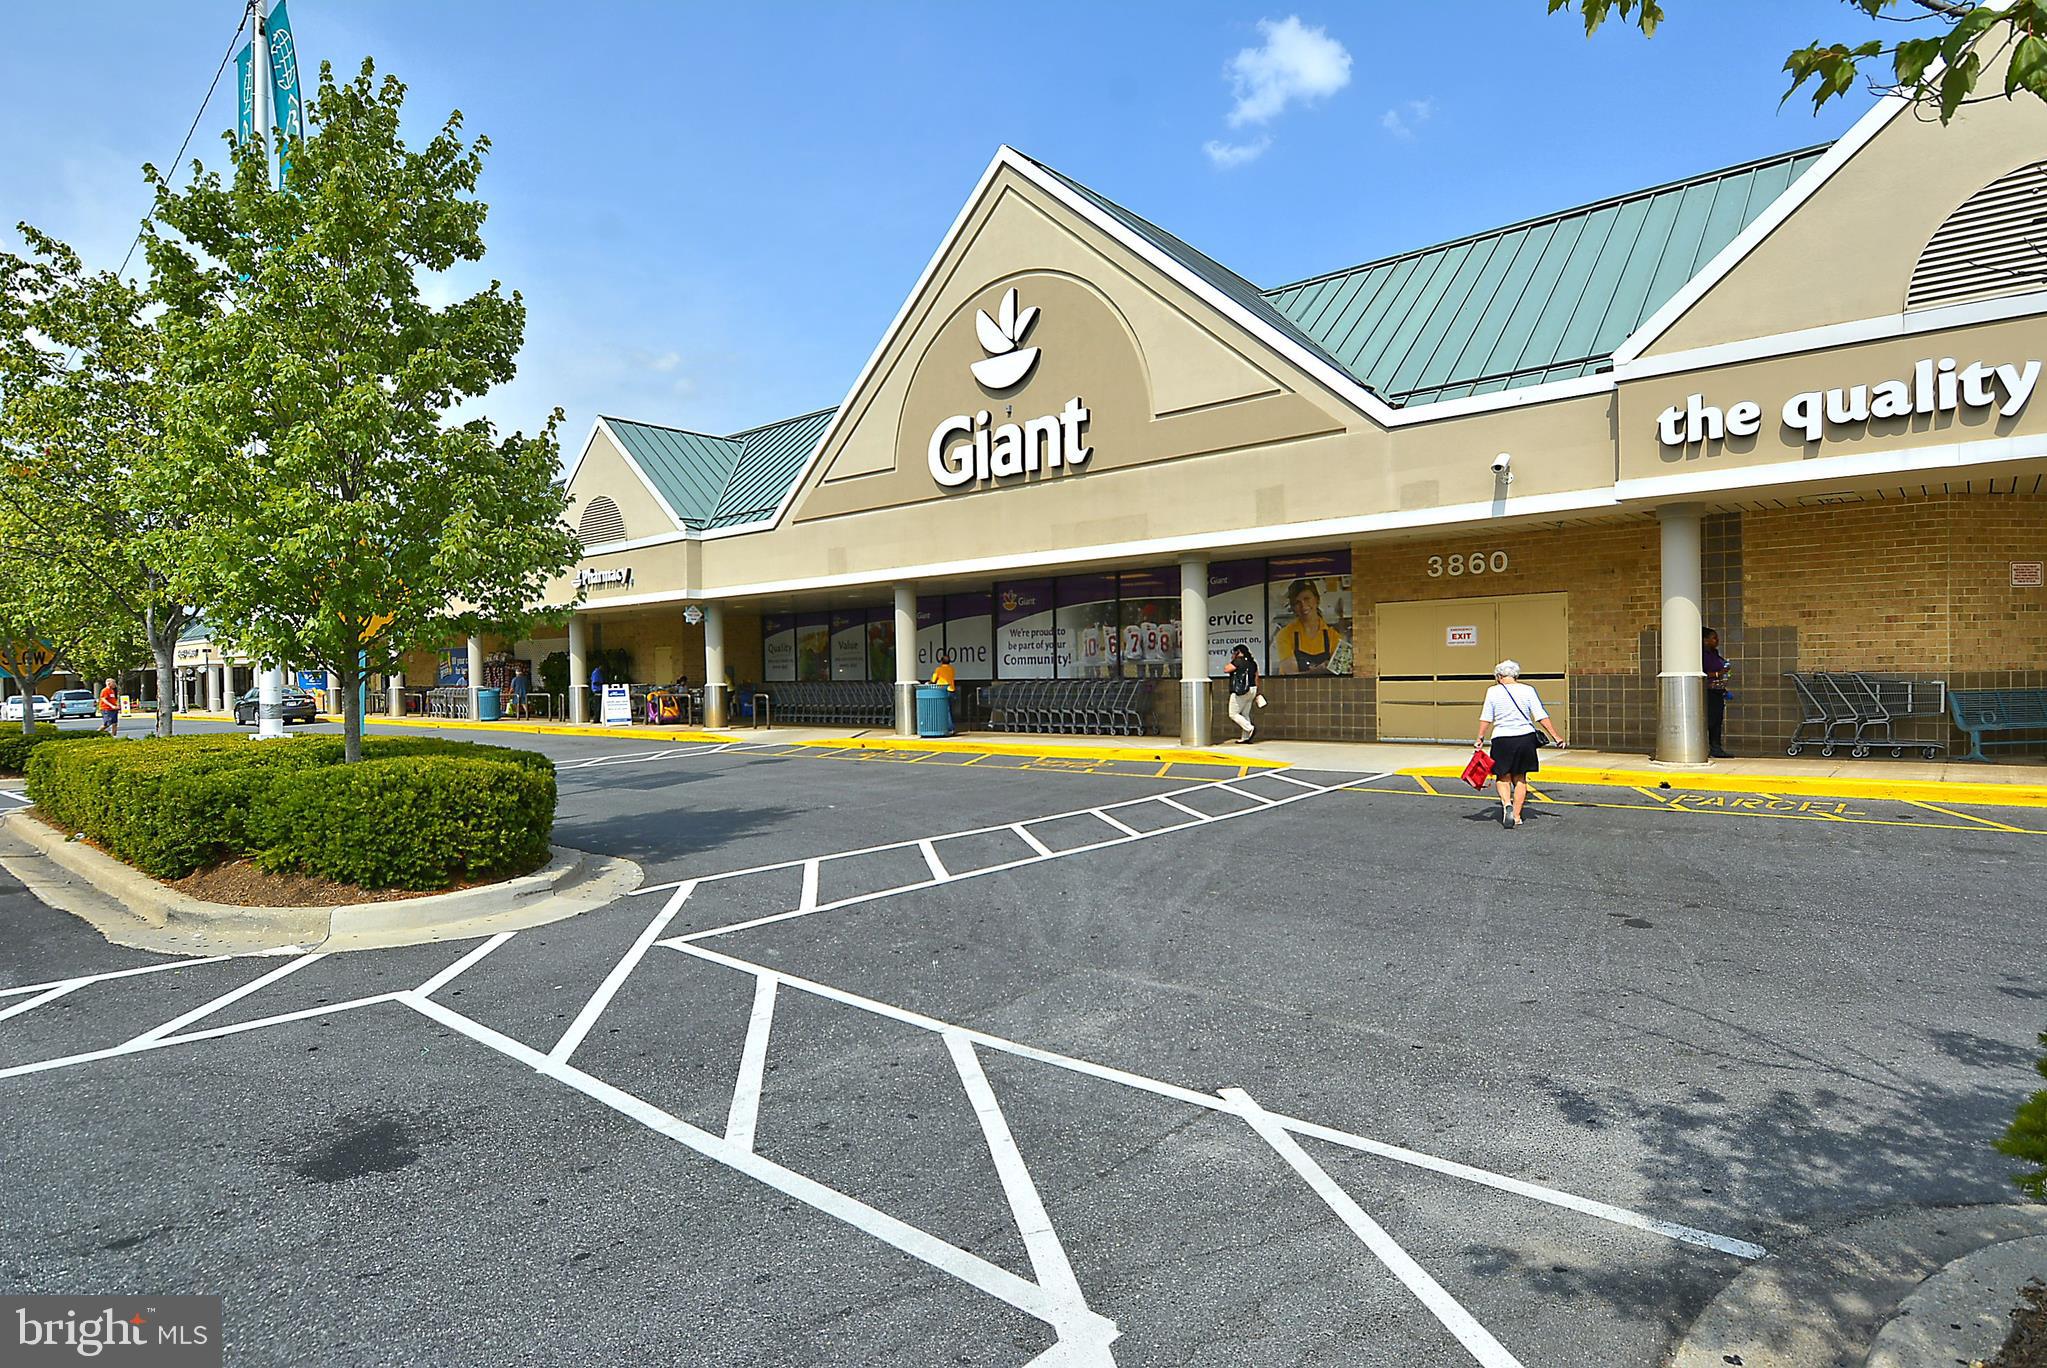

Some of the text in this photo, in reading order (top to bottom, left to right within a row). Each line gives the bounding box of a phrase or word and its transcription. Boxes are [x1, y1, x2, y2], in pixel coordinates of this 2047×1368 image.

[1656, 357, 2042, 446] the quality
[928, 396, 1094, 487] Giant
[1427, 551, 1508, 577] 3860
[1209, 576, 1228, 585] Giant
[1017, 596, 1036, 607] Giant
[1208, 610, 1254, 626] ervice
[1009, 626, 1066, 639] We're proud to
[1226, 636, 1247, 645] count
[1249, 636, 1262, 644] on,
[767, 643, 793, 655] Quality
[838, 641, 859, 650] Value
[1008, 639, 1066, 652] be part of your
[1130, 633, 1139, 653] 7
[1148, 632, 1157, 651] 9
[918, 641, 987, 664] elcome
[1003, 652, 1072, 668] Community!
[1670, 794, 1867, 816] PARCEL
